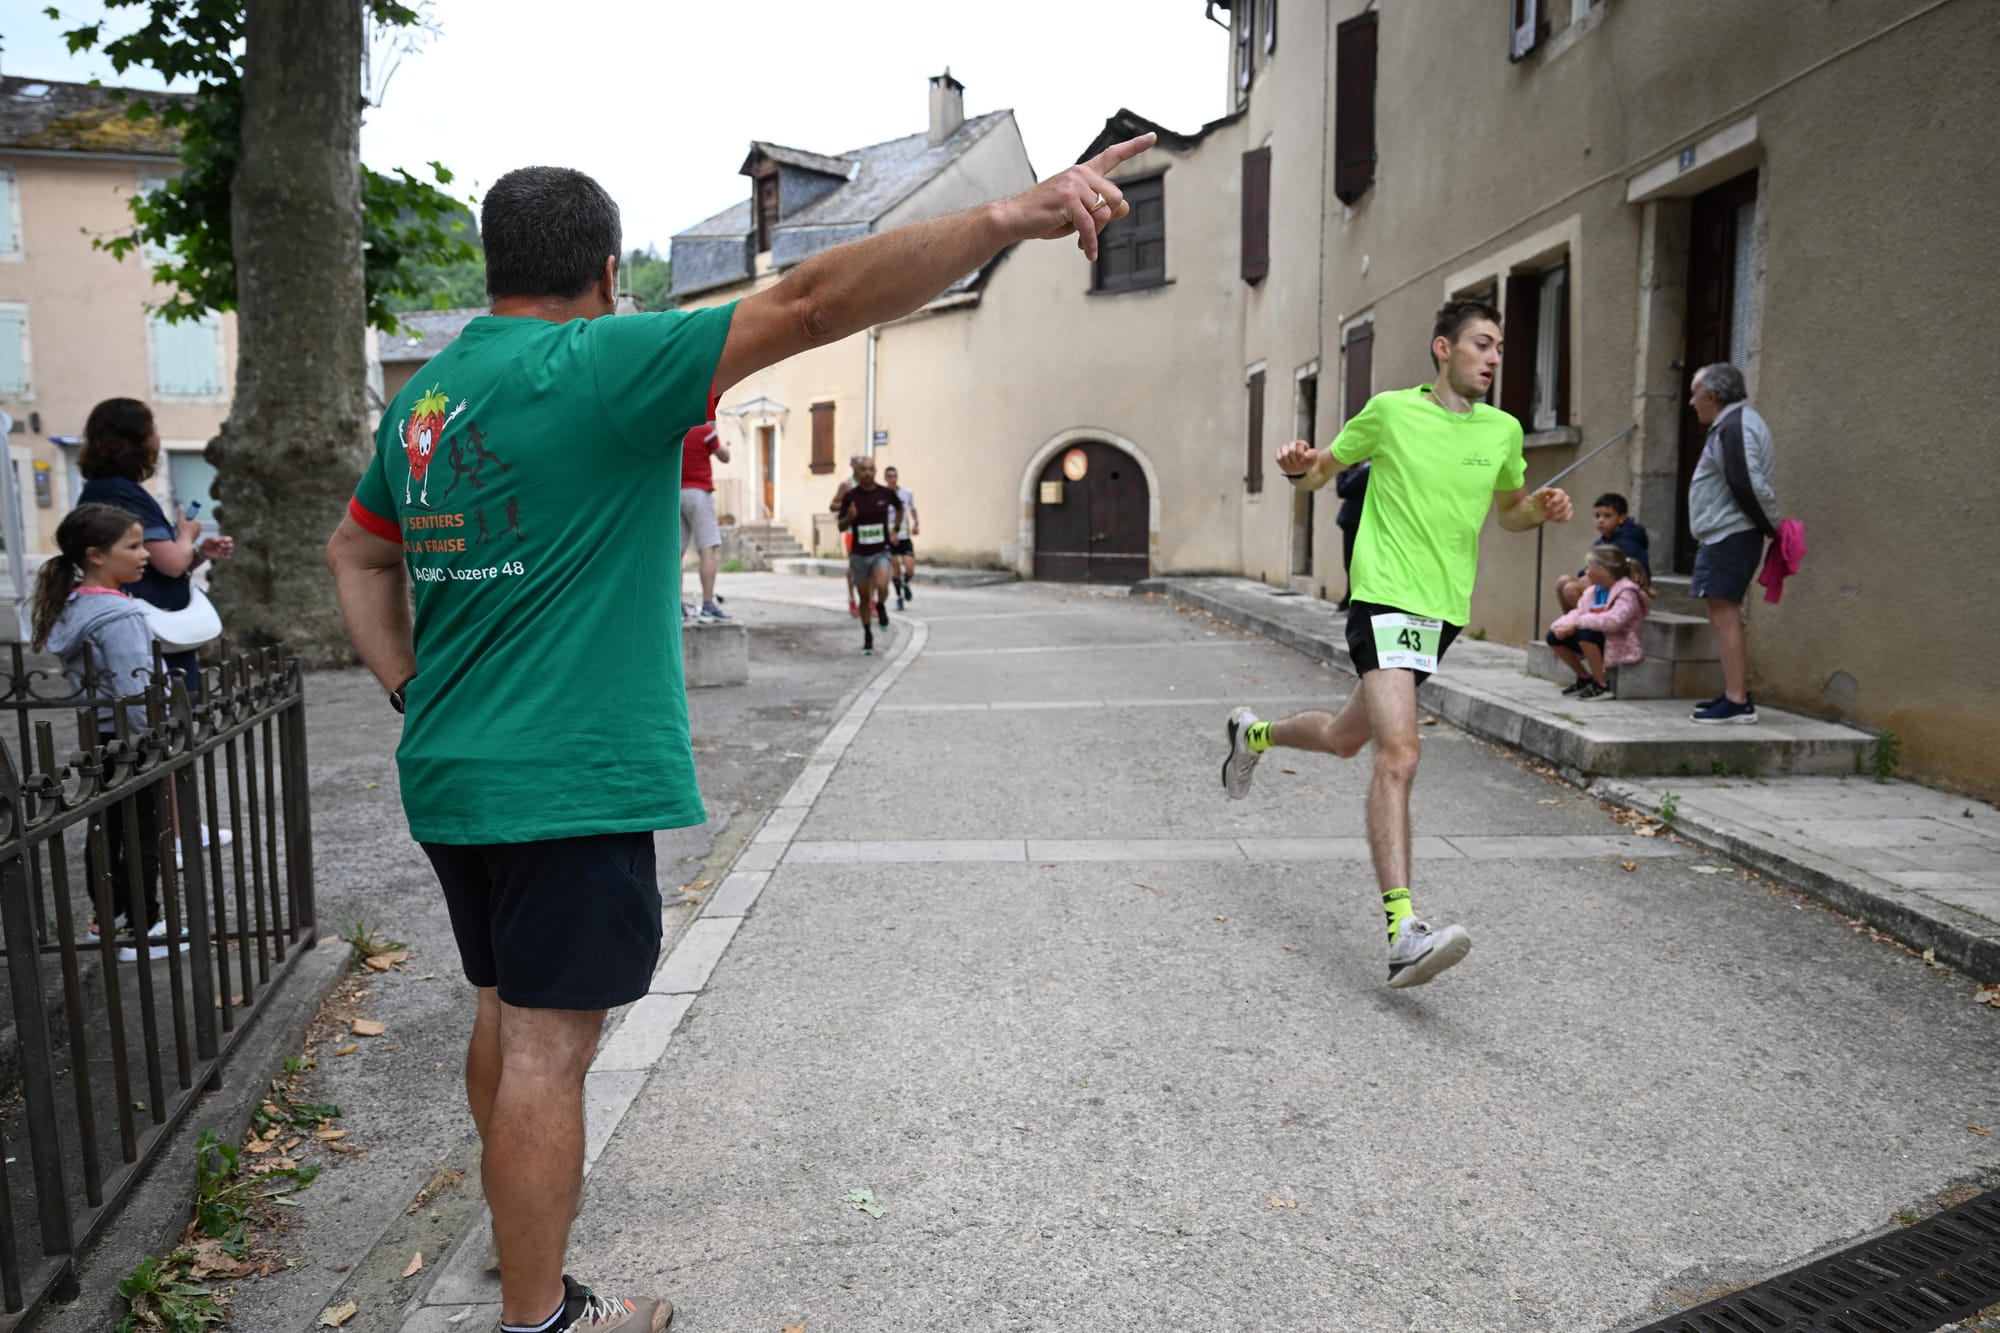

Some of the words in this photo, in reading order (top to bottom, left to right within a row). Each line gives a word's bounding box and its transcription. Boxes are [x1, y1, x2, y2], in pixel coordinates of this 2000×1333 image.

[409, 513, 465, 530] SENTIERS
[424, 538, 467, 552] FRAISE
[447, 566, 498, 580] Lozere
[501, 561, 525, 576] 48
[1396, 627, 1422, 652] 43
